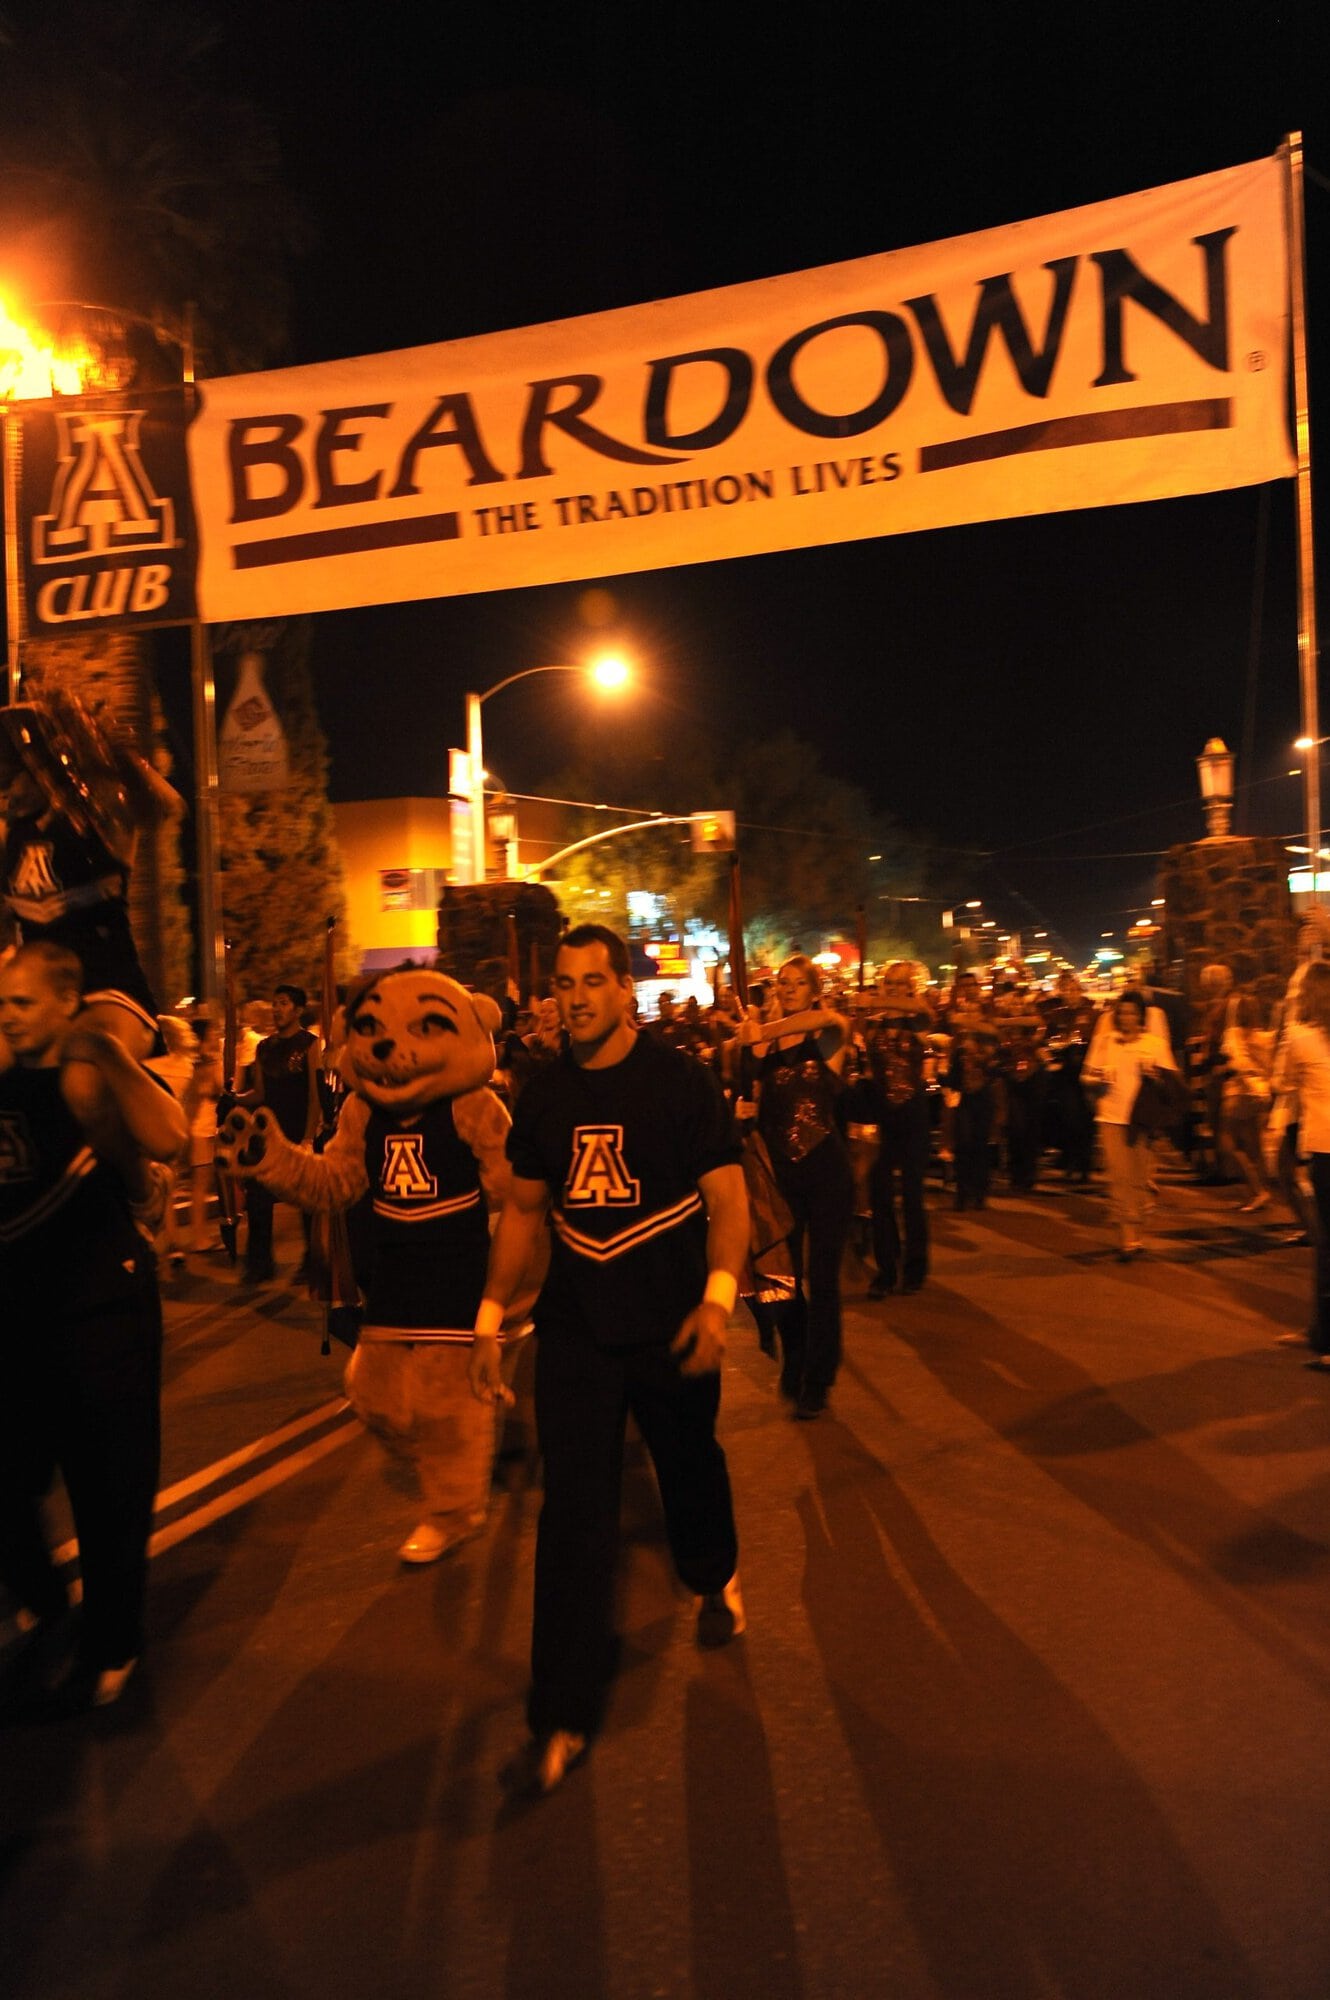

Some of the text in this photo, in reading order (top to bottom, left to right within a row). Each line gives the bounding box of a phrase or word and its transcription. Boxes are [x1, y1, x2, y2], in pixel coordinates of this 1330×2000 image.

[31, 409, 176, 565] A
[473, 452, 902, 537] THE TRADITION LIVES
[36, 564, 172, 624] CLUB
[382, 1134, 437, 1198] A
[564, 1125, 640, 1208] A
